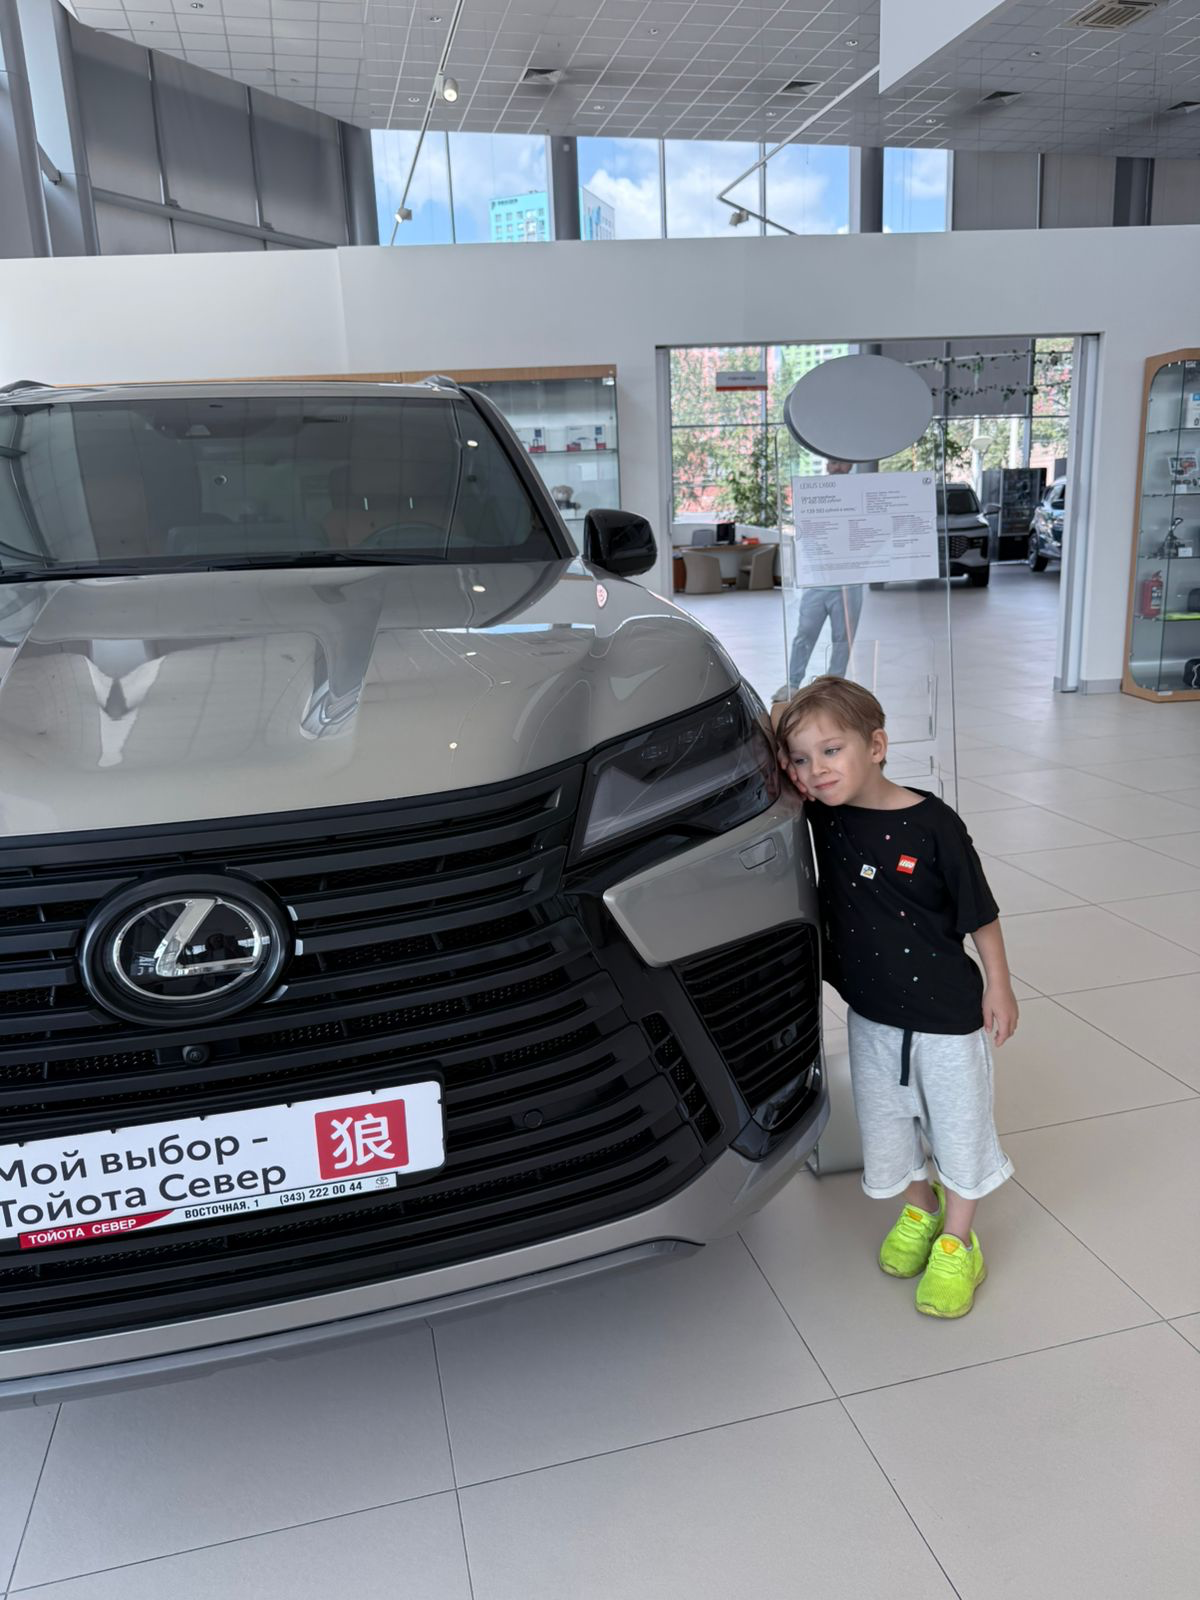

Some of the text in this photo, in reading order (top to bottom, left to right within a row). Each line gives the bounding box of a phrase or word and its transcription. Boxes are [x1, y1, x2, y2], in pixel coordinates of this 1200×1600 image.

[0, 1149, 87, 1188] Мой
[100, 1134, 240, 1175] выбор
[330, 1113, 395, 1169] 狼
[0, 1165, 286, 1228] Тойота Север
[254, 1199, 259, 1207] 1
[279, 1193, 306, 1205] (343)
[309, 1186, 329, 1199] 222
[332, 1184, 346, 1194] 00
[349, 1181, 363, 1192] 44
[28, 1219, 137, 1245] ТОЙОТА СЕВЕР
